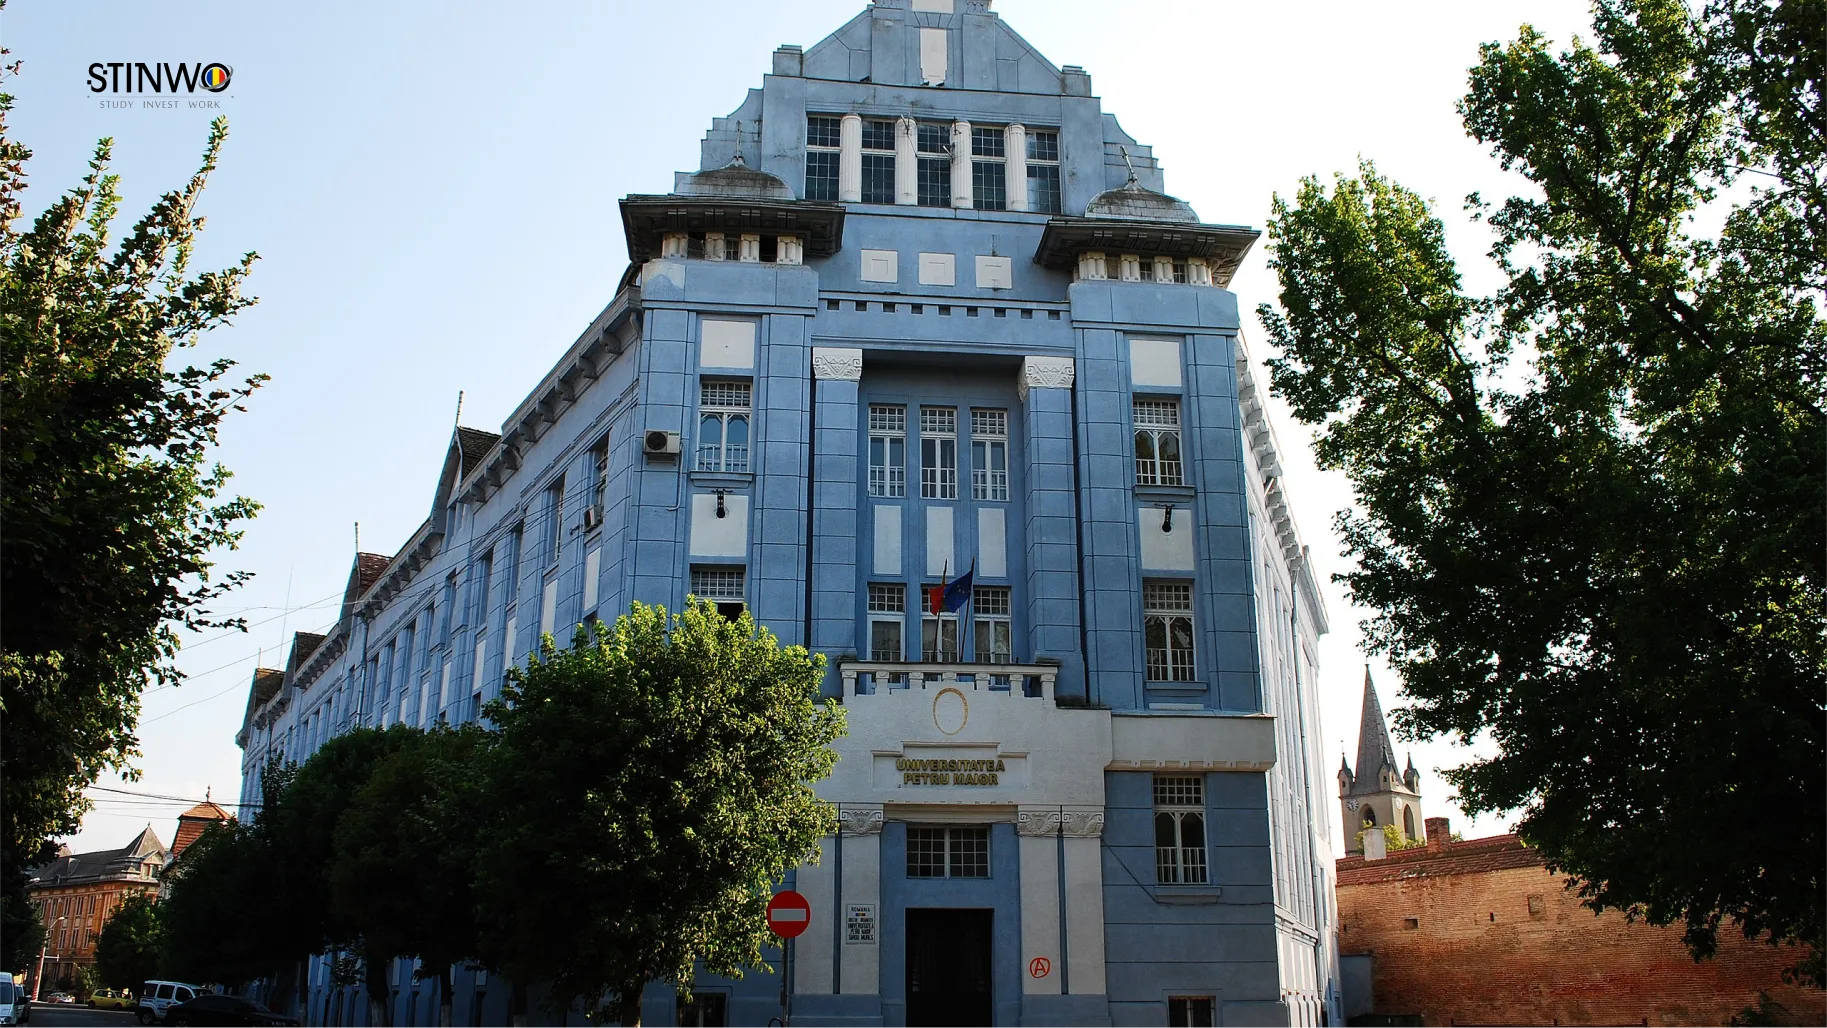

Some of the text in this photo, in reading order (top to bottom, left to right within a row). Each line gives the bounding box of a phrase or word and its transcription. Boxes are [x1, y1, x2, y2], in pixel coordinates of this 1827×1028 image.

[896, 759, 1005, 771] UNIVERSITATEA
[904, 773, 999, 786] PETRU MAIOR
